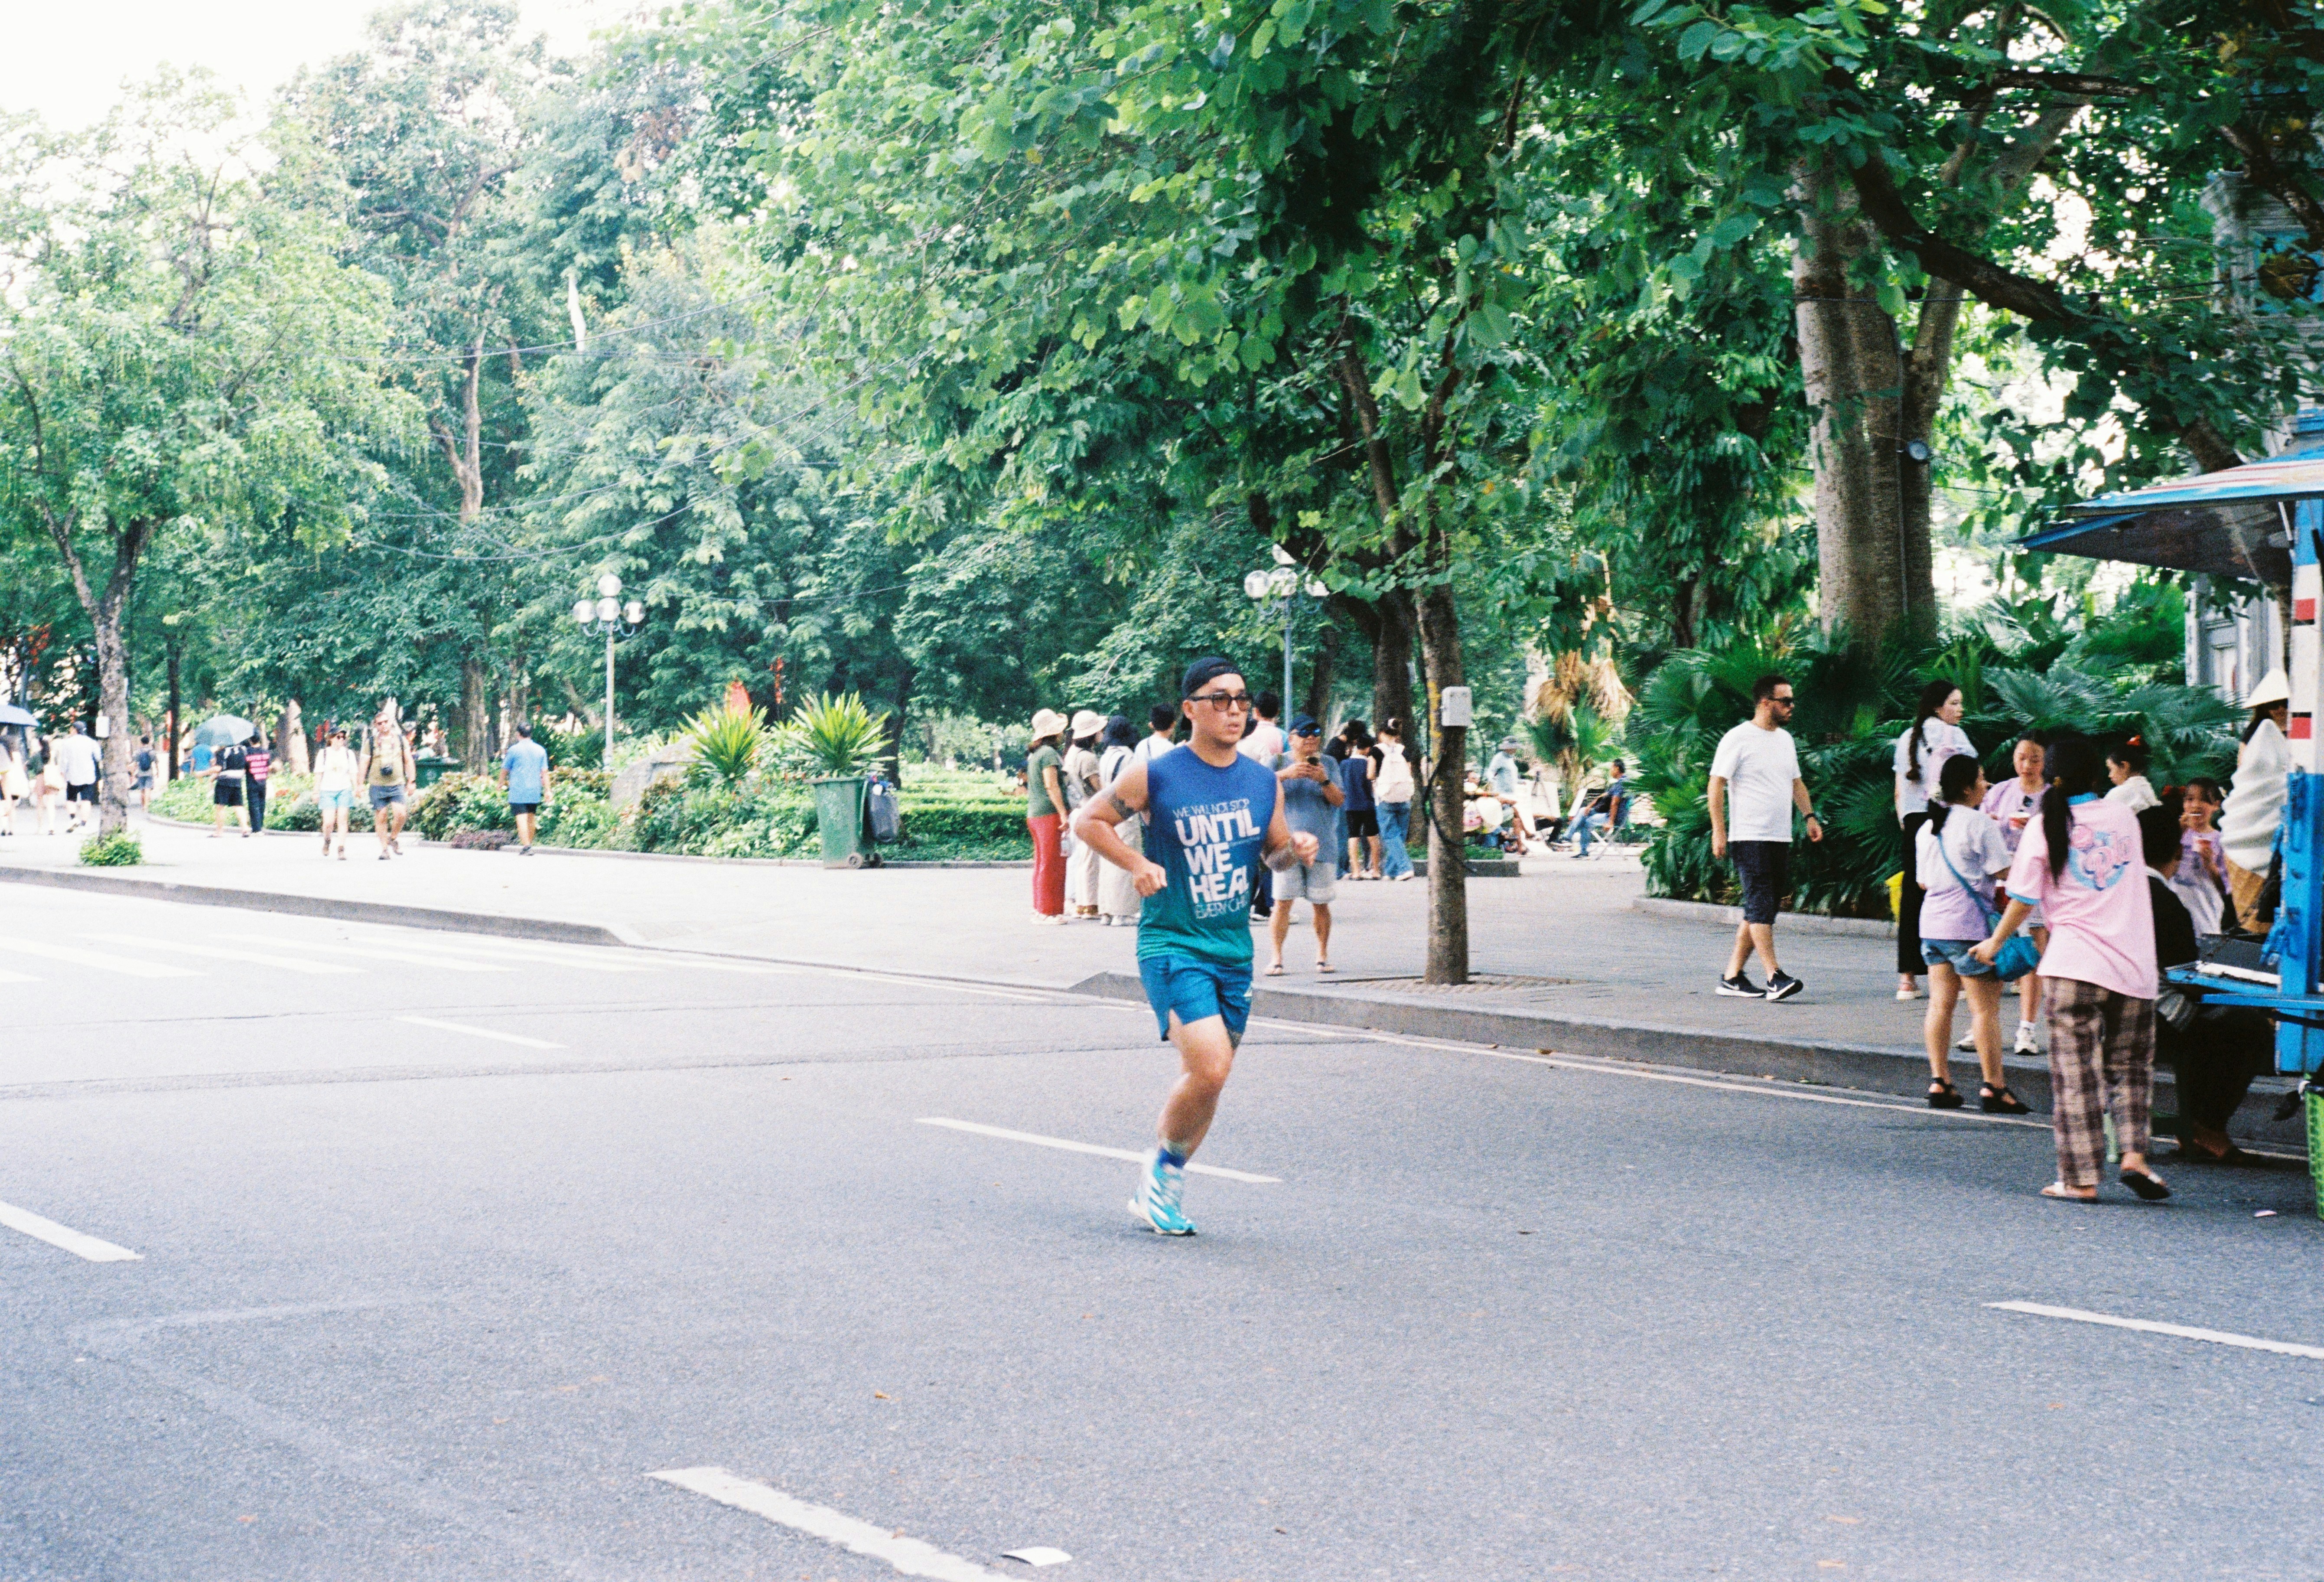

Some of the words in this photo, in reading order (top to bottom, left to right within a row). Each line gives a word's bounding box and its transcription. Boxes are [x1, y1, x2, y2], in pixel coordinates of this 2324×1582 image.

[1172, 806, 1190, 819] WE
[1211, 802, 1229, 813] NOT
[1229, 798, 1250, 811] STOP
[1175, 808, 1260, 846] UNTIL
[1184, 842, 1233, 875] WE
